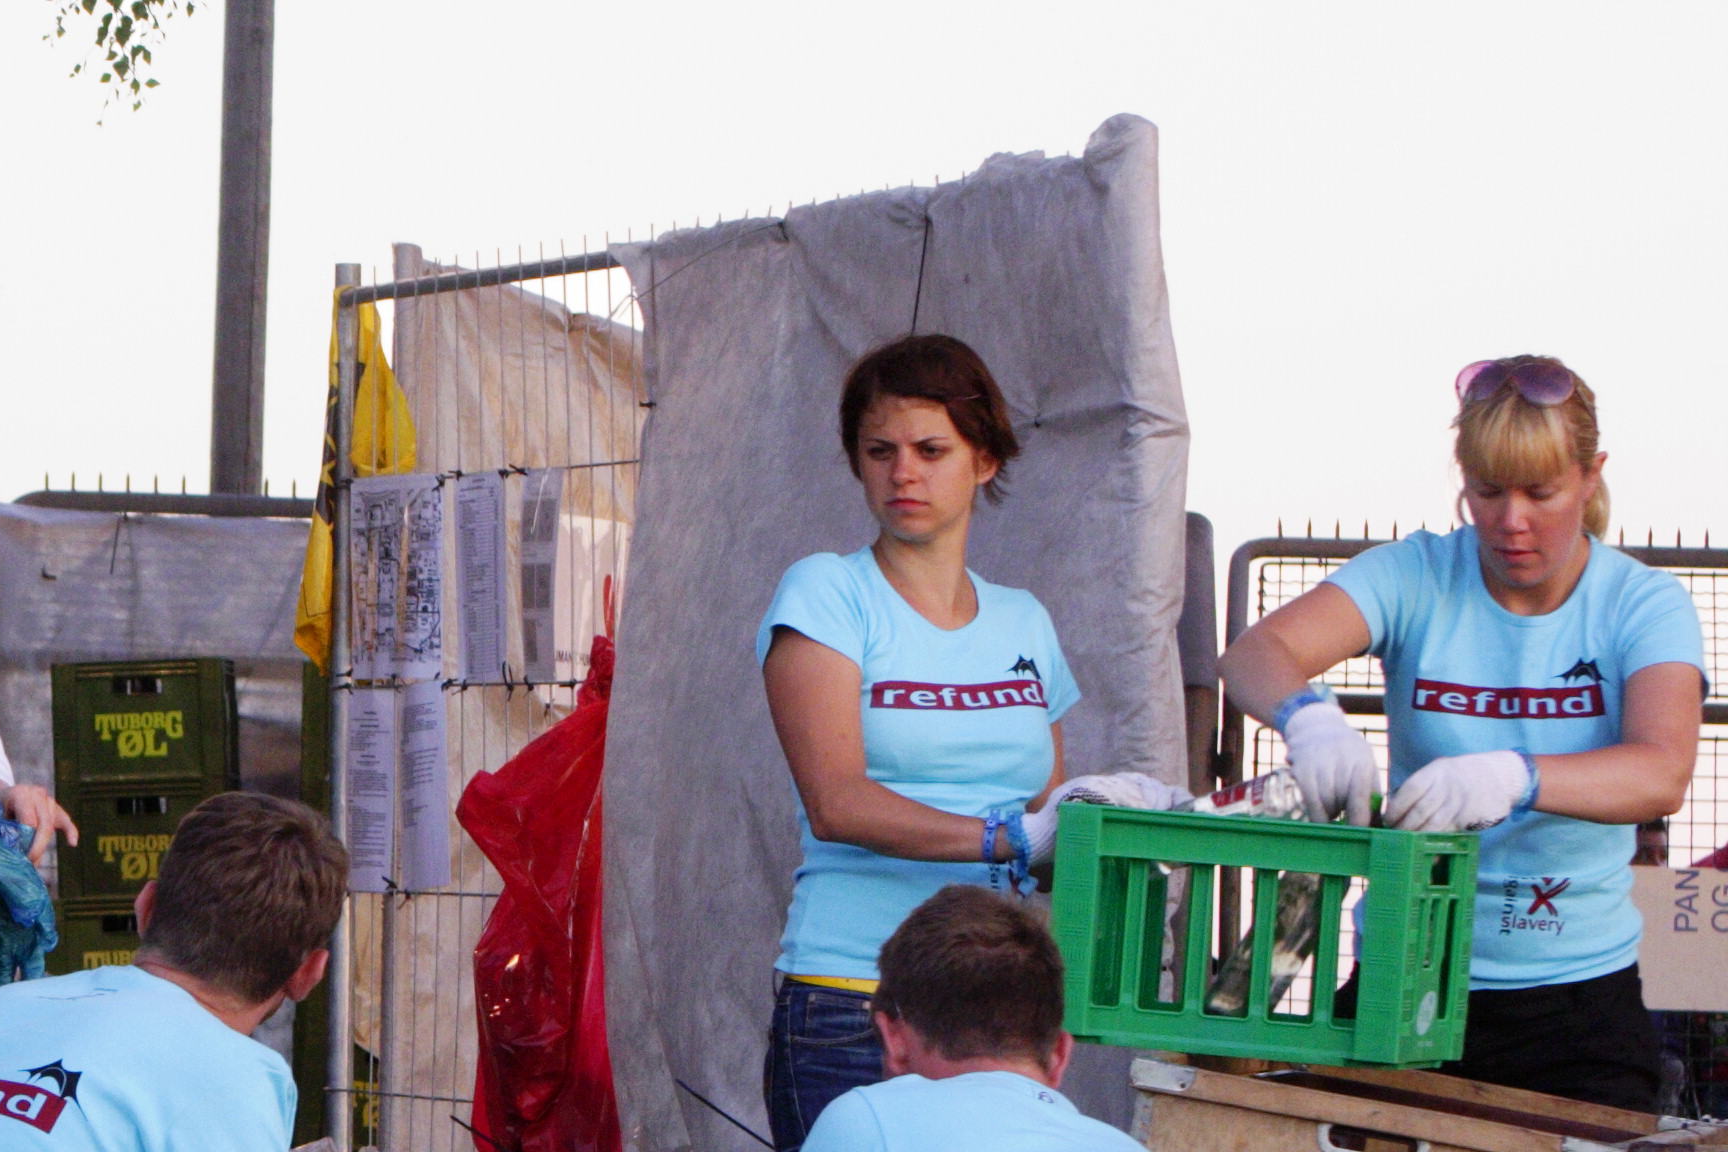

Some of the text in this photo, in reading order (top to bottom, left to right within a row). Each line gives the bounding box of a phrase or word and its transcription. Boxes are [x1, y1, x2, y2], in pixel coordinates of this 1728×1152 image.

[882, 683, 1043, 707] refund
[1414, 687, 1594, 715] refund
[95, 710, 184, 740] TUBORG
[117, 729, 168, 759] ØL
[98, 834, 176, 862] TUBOR
[1501, 914, 1566, 936] slavery
